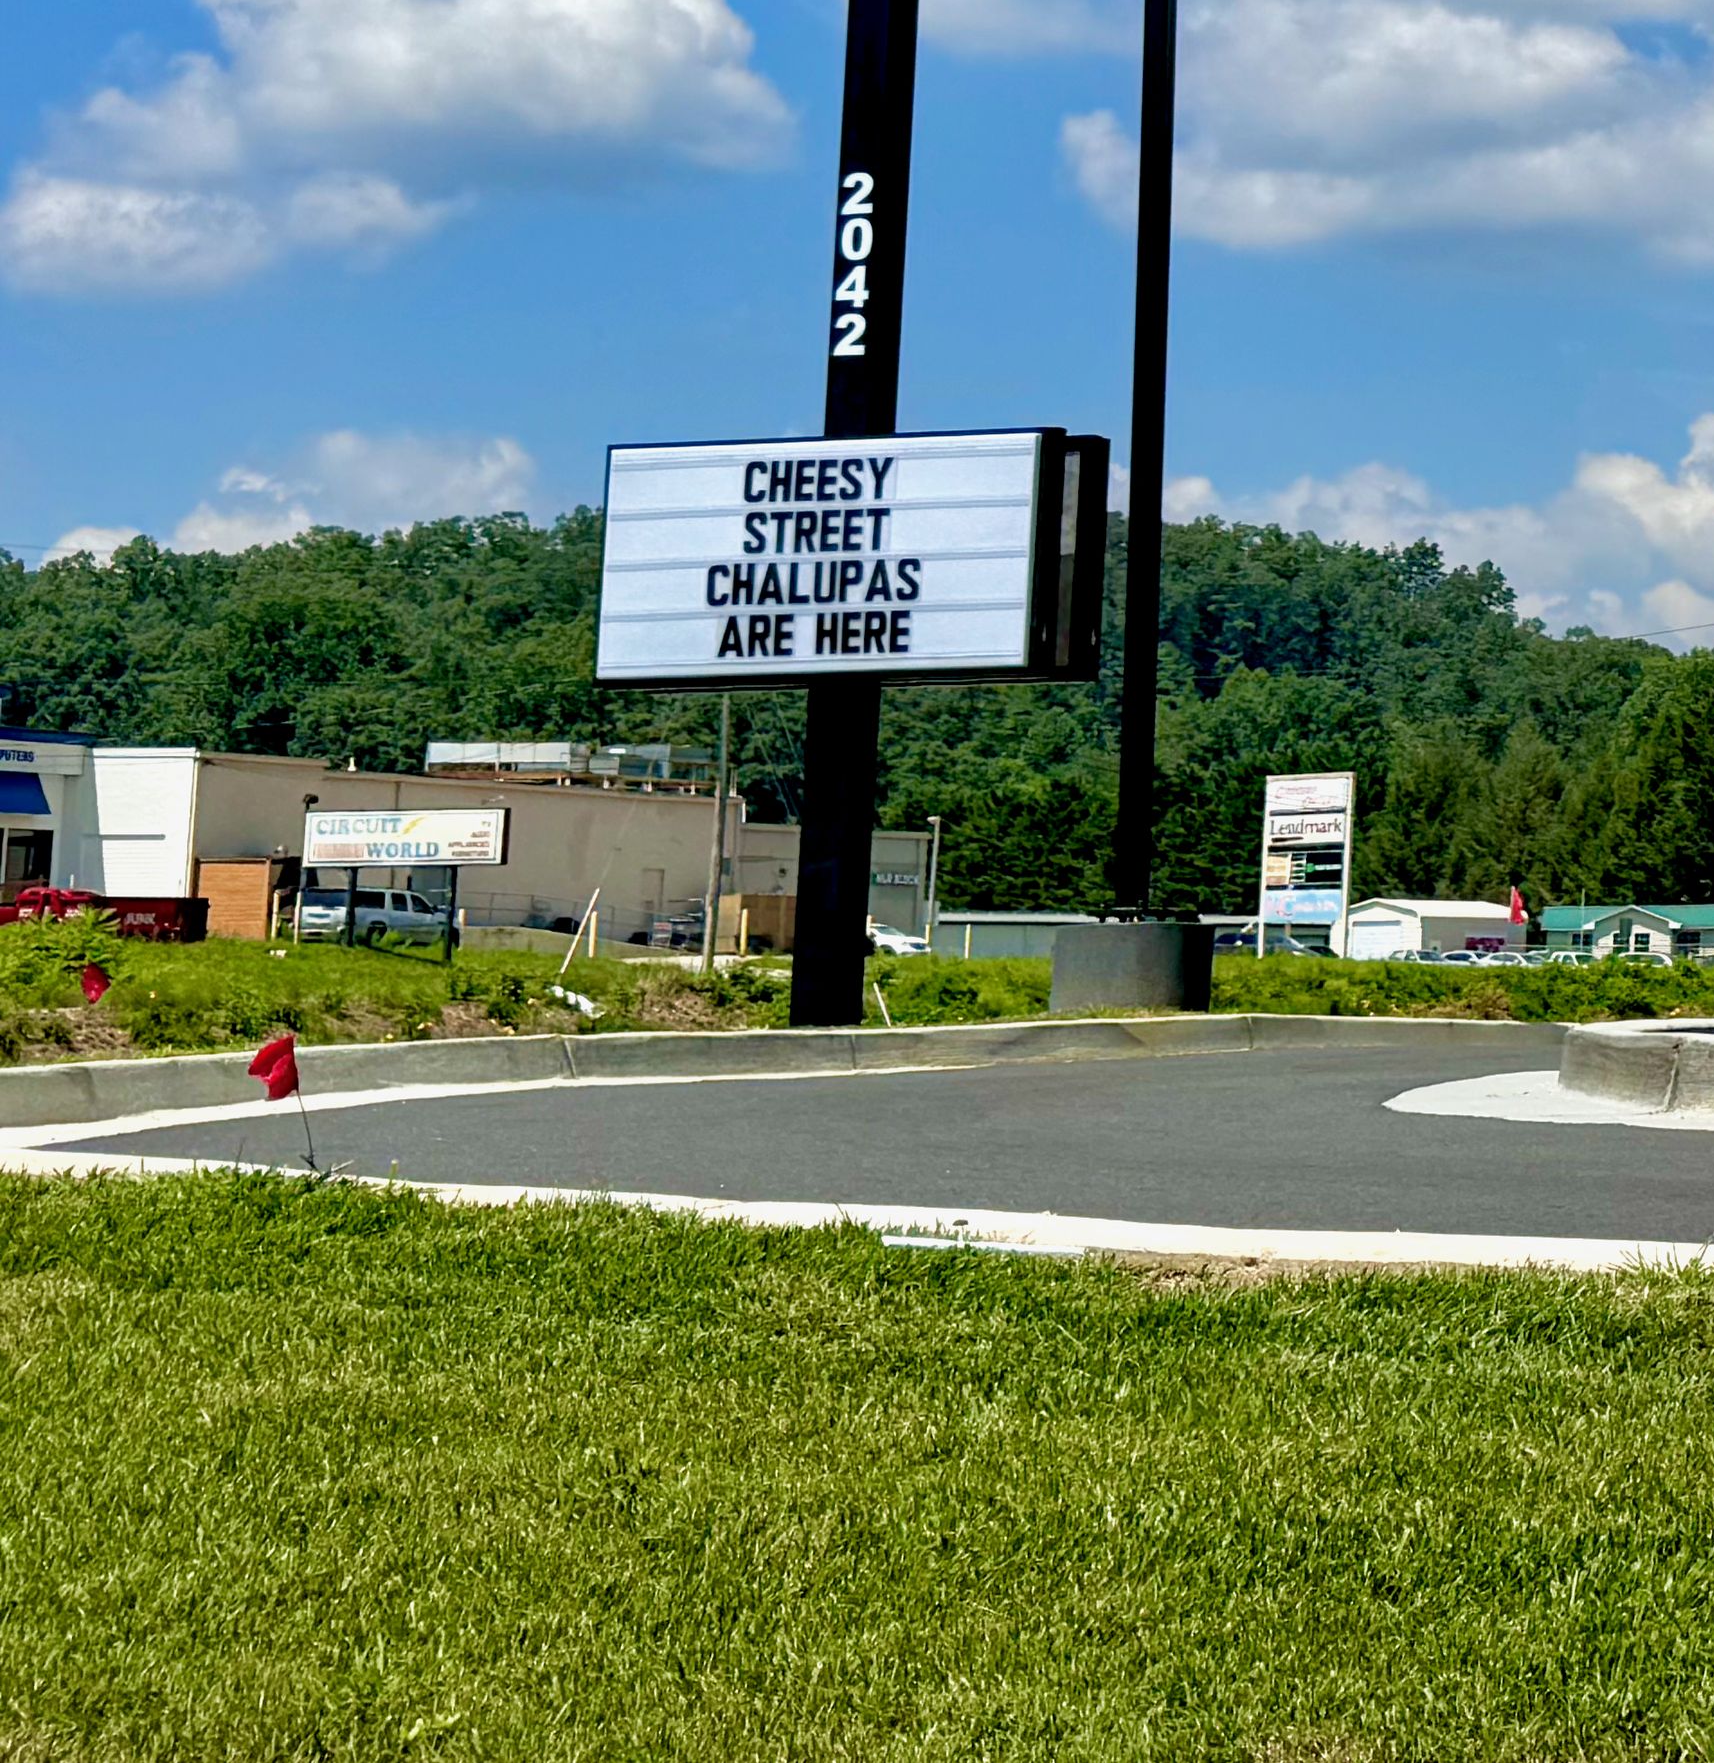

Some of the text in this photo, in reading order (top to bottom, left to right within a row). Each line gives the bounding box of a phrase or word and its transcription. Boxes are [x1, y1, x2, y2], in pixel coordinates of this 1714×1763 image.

[832, 172, 875, 357] 2042
[743, 457, 895, 503] CHEESY
[743, 507, 891, 554] STREET
[706, 558, 921, 607] CHALUPAS
[717, 610, 911, 658] ARE HERE
[316, 818, 403, 836] CIRCUIT
[1269, 816, 1343, 836] Lendmark
[366, 842, 440, 859] WORLD
